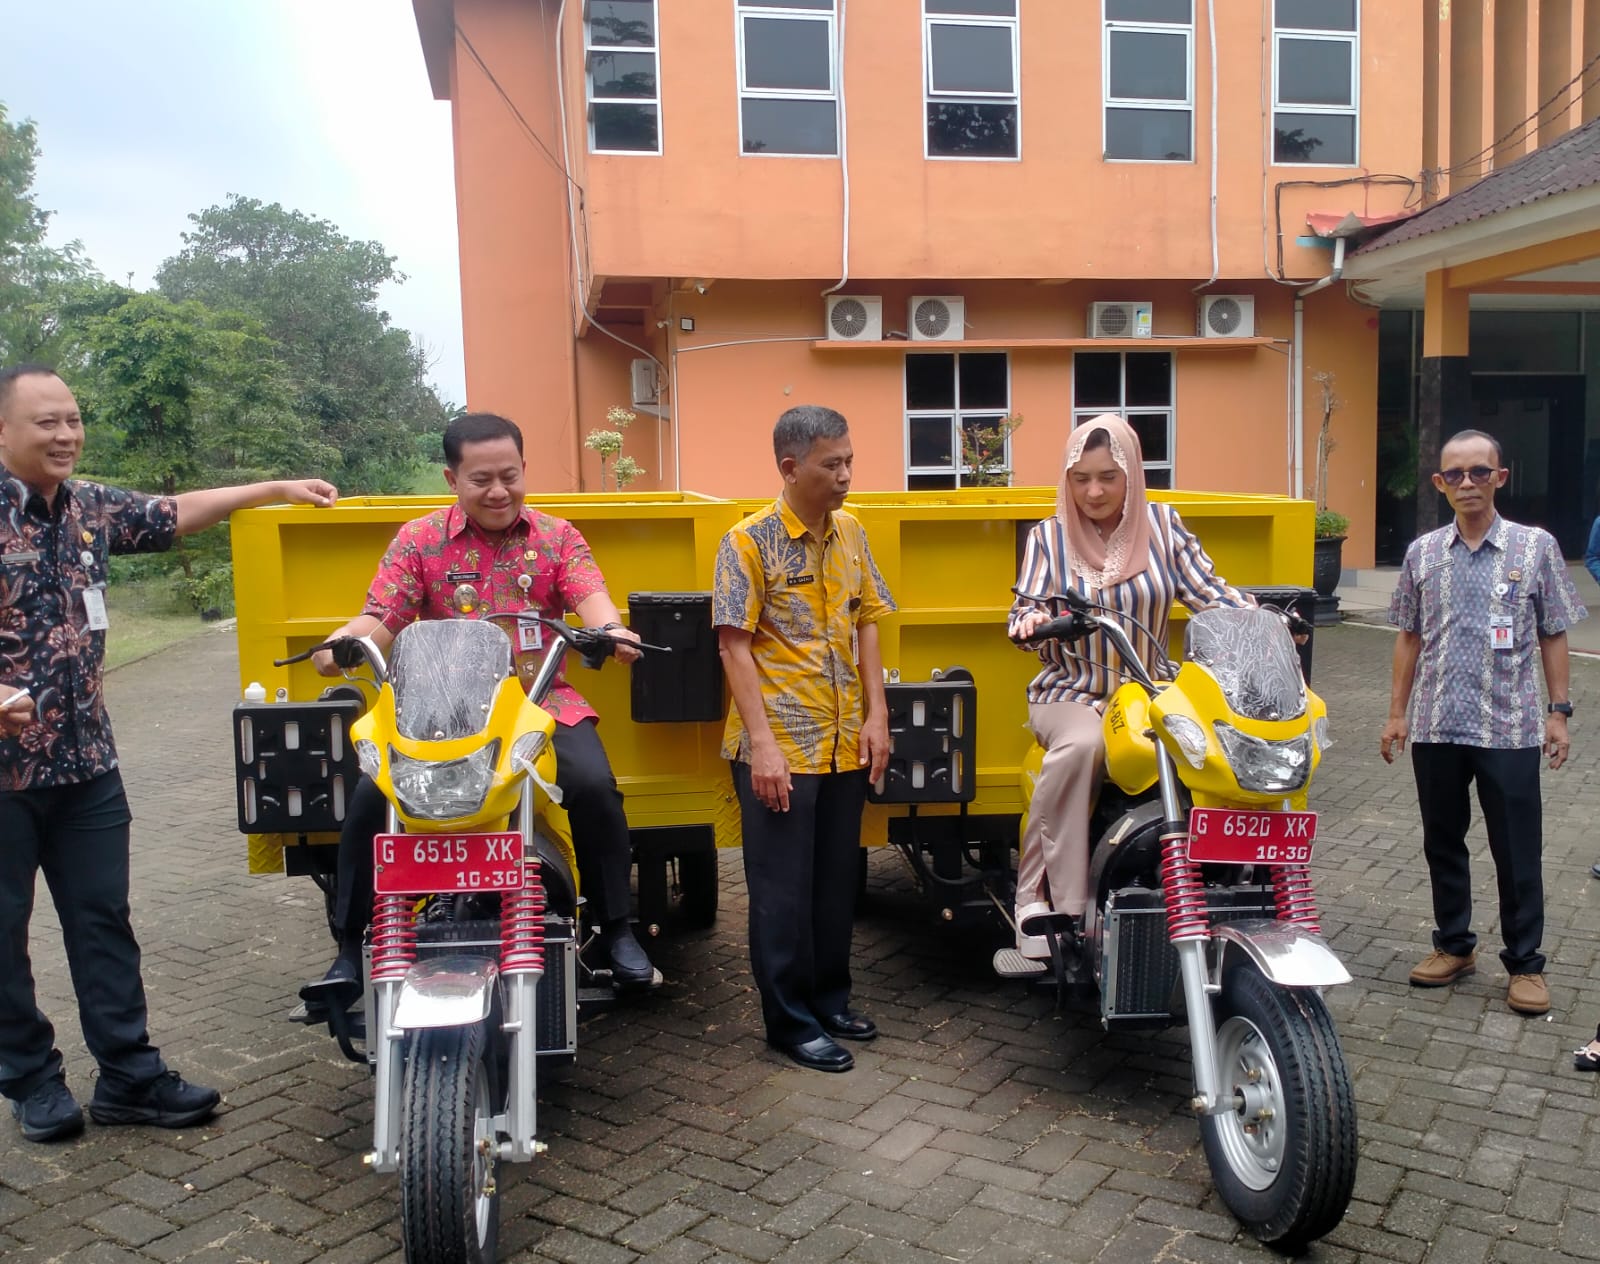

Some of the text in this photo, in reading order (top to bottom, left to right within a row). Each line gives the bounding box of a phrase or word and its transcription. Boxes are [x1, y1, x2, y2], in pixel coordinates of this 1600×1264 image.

[1197, 814, 1310, 838] G 6520 XK
[382, 838, 514, 863] G 6515 XK
